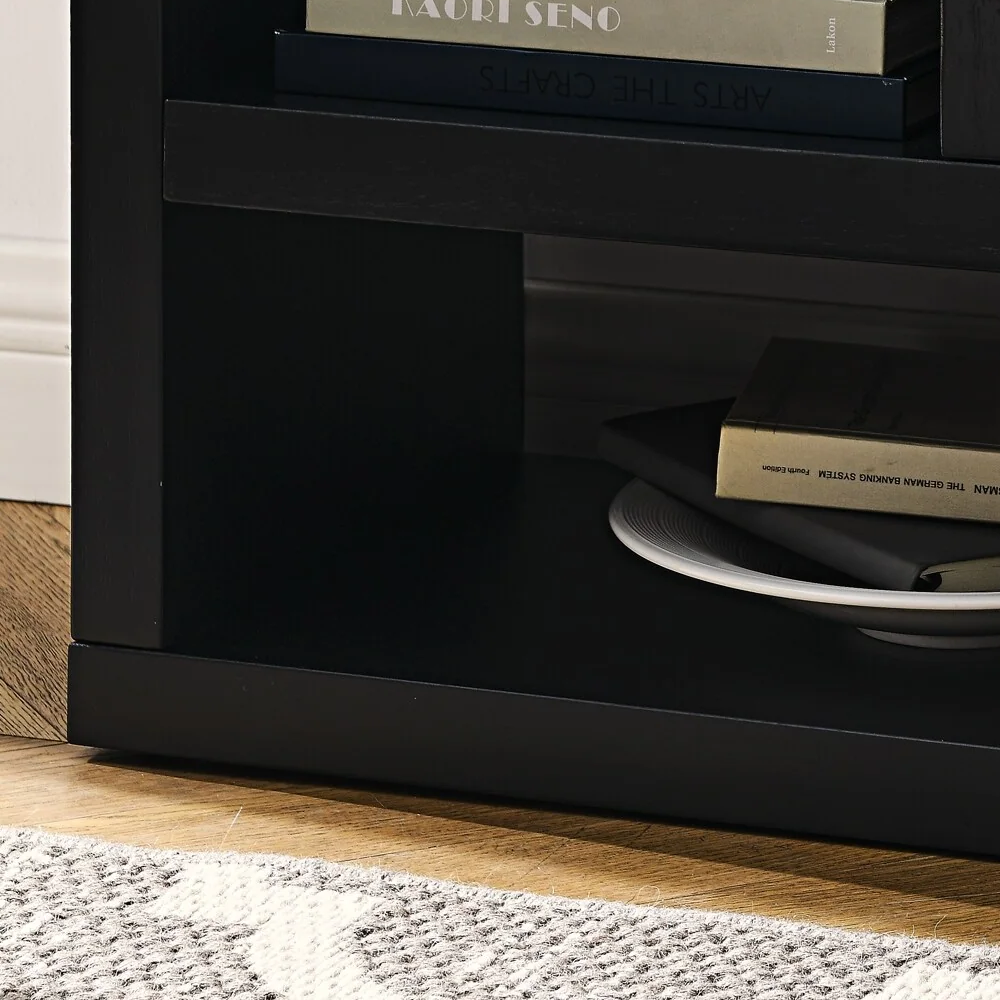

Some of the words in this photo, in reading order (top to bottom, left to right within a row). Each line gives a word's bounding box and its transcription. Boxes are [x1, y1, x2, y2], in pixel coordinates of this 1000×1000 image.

[524, 0, 621, 32] SENO
[826, 17, 836, 53] Lakon
[480, 65, 596, 99] CRAFTS
[613, 74, 677, 106] THE
[693, 80, 772, 112] ARTS
[762, 464, 786, 474] Edition
[787, 467, 810, 476] Fourth
[818, 469, 857, 481] SYSTEM
[859, 473, 901, 485] BANKING
[903, 477, 944, 489] GERMAN
[946, 482, 966, 491] THE
